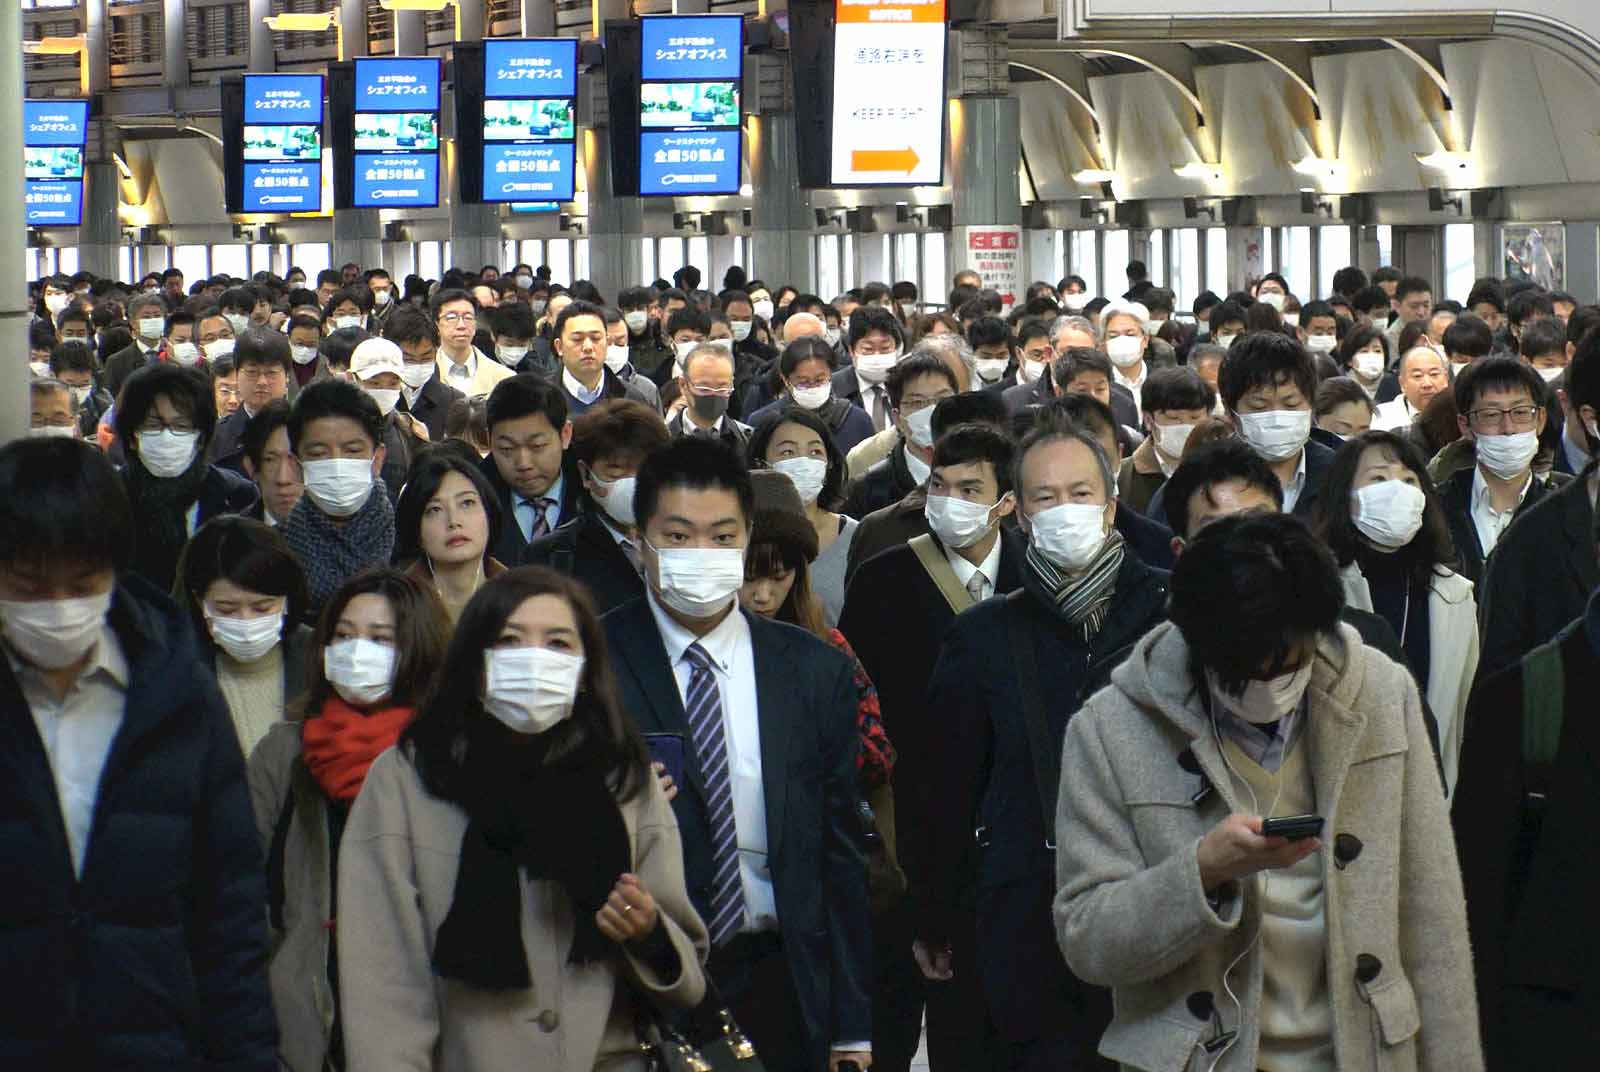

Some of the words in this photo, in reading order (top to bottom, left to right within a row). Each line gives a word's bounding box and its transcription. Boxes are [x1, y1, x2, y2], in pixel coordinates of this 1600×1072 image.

[655, 48, 728, 61] シェアオフィス
[497, 68, 563, 80] シェアオフィス
[367, 85, 428, 95] シェアオフィス
[255, 99, 311, 109] シェアオフィス
[654, 148, 725, 163] 全国50拠点
[496, 159, 561, 173] 全国50拠点
